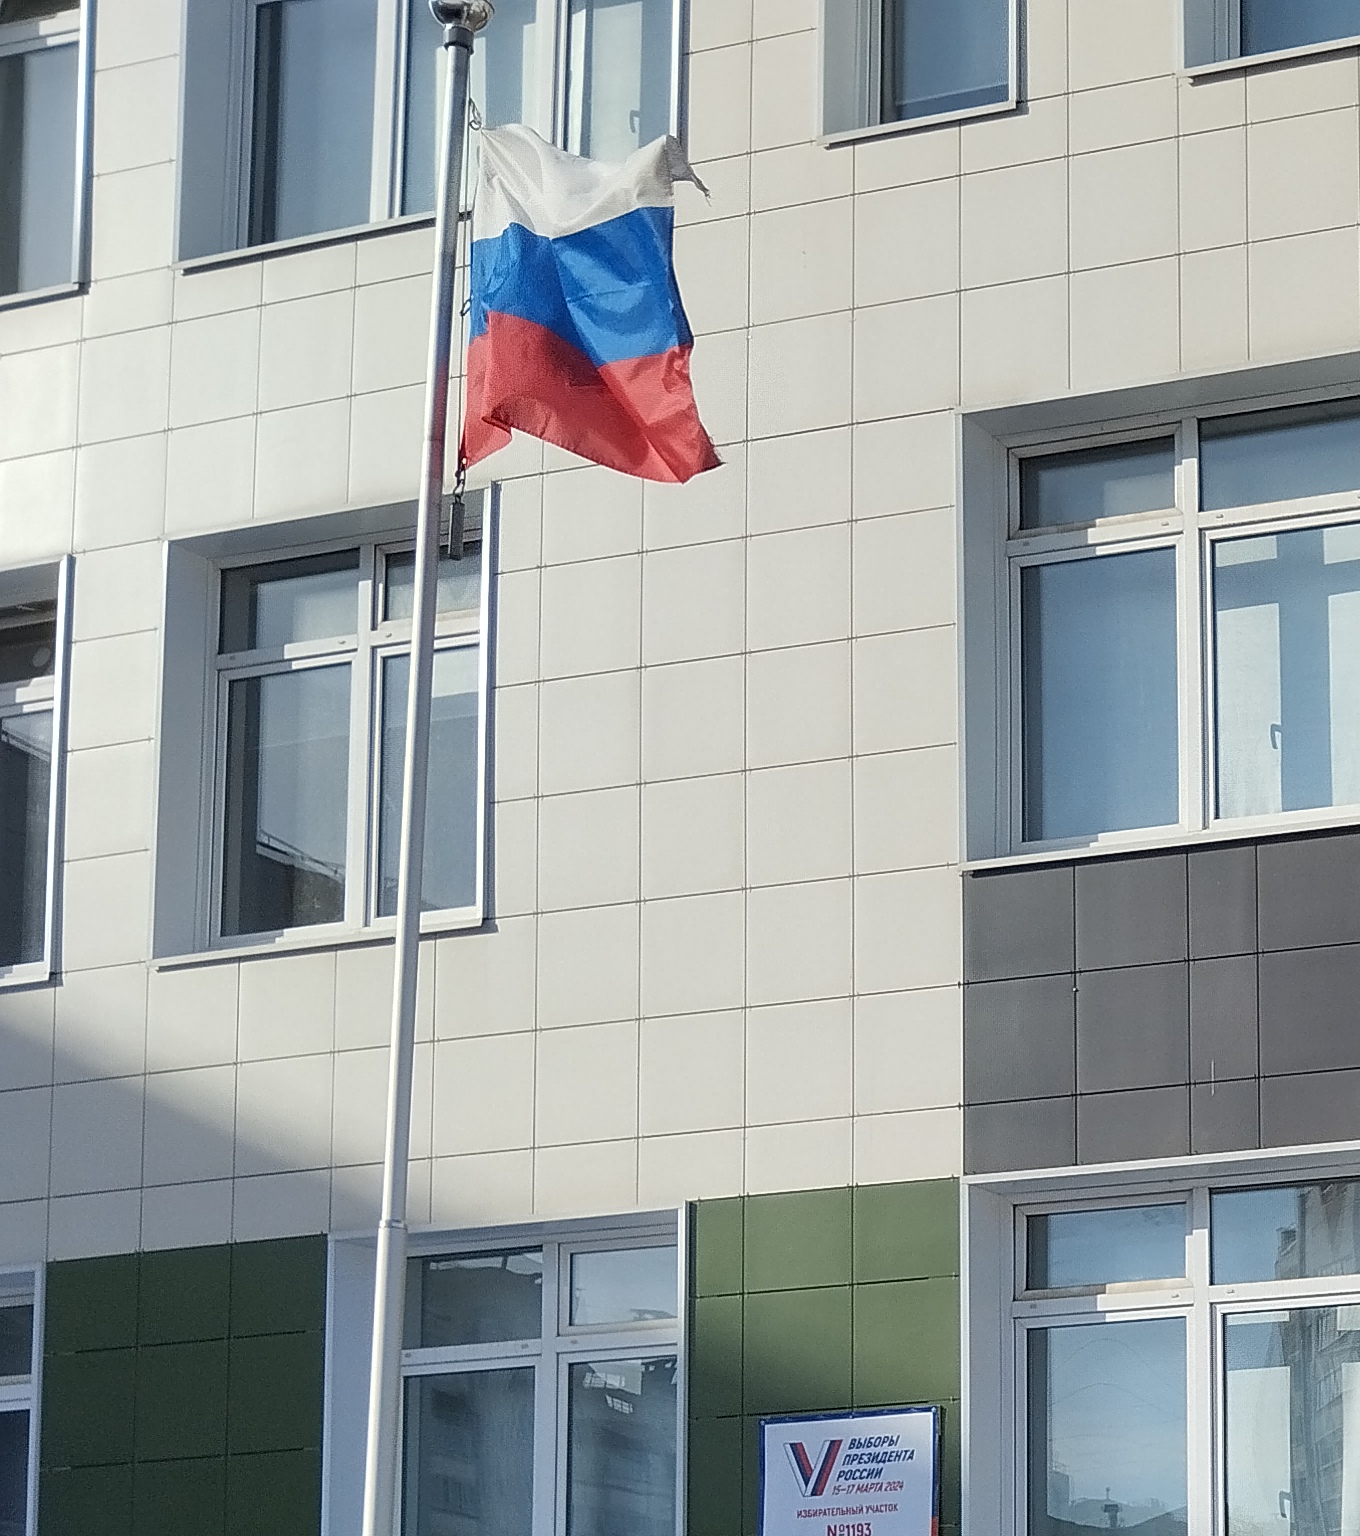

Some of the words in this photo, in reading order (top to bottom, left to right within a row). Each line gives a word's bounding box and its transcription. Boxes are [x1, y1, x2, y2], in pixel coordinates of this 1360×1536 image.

[848, 1435, 900, 1450] ВЫБОРЫ
[842, 1449, 915, 1467] ПРЕЗИДЕНТА
[836, 1467, 884, 1482] РОССИИ
[855, 1482, 883, 1494] МАРТА
[884, 1480, 904, 1492] 2024
[796, 1506, 864, 1519] ИЗБИРАТЕЛЬНЫЙ
[865, 1503, 898, 1515] УЧАСТОК
